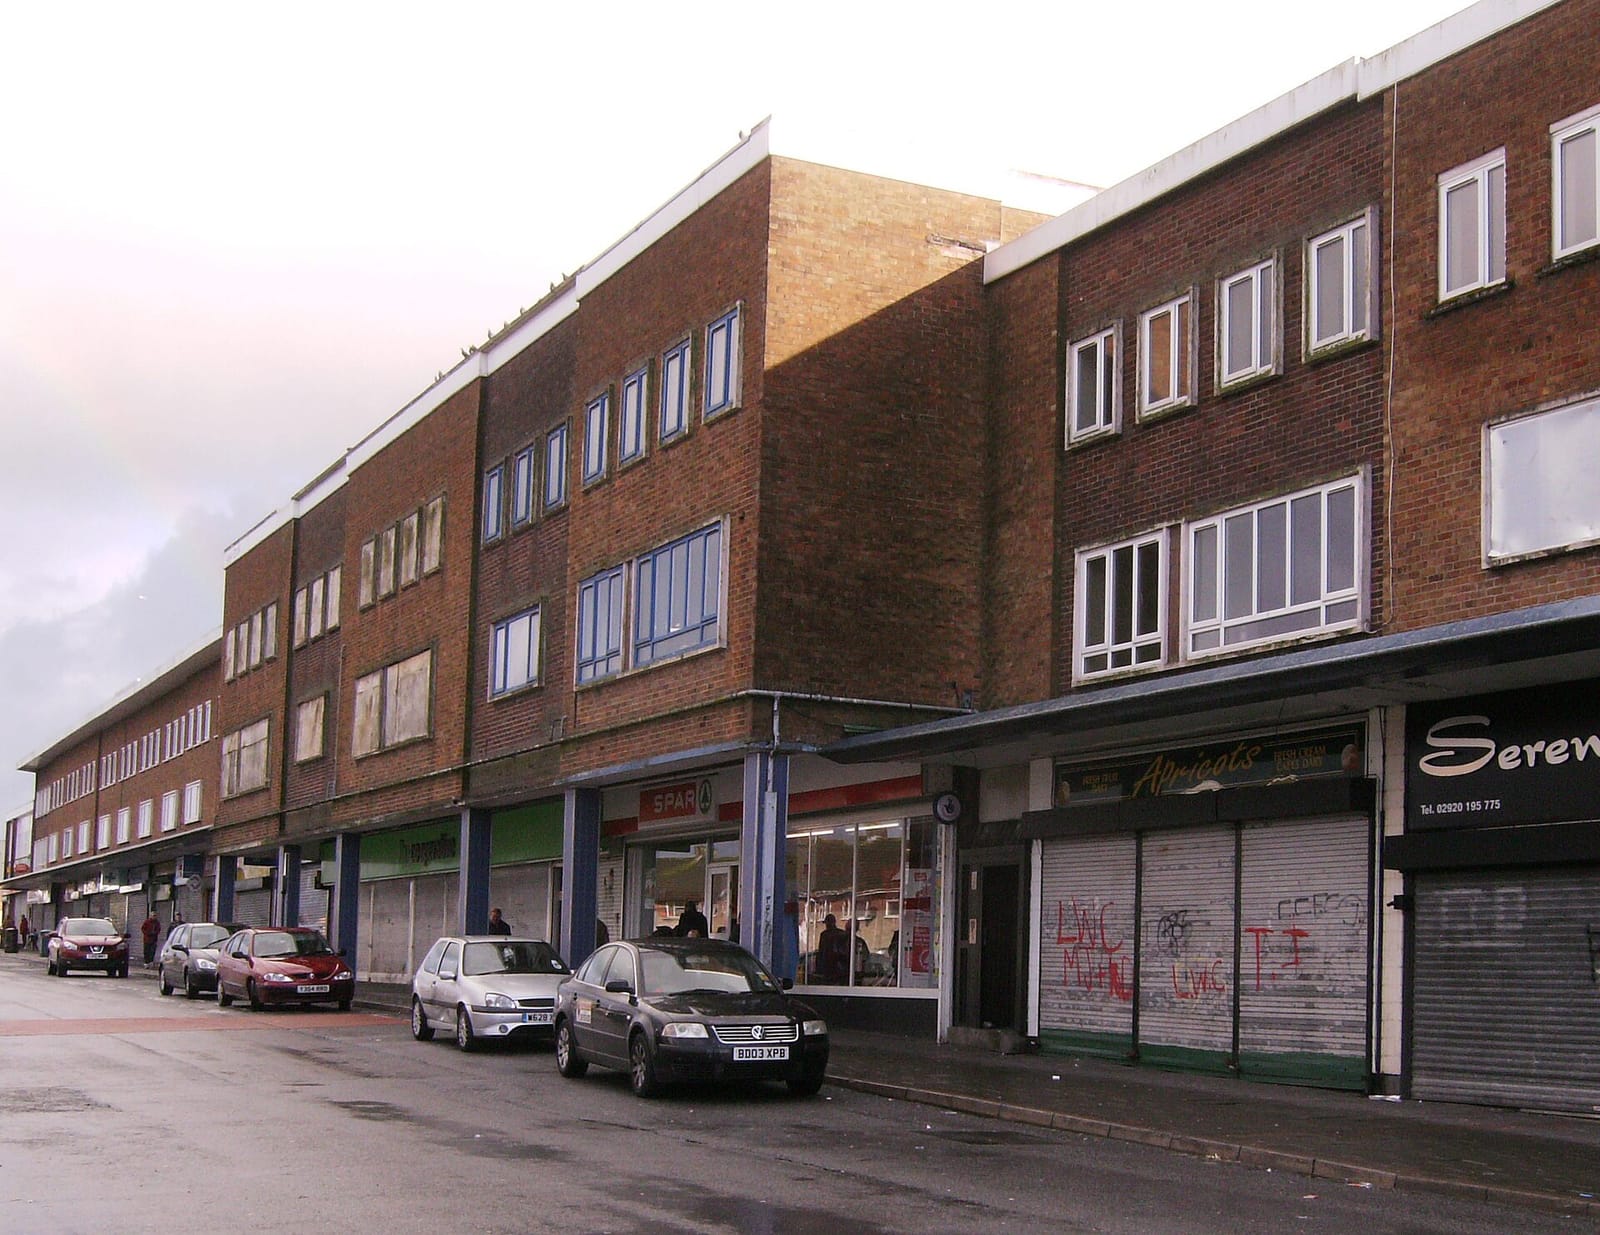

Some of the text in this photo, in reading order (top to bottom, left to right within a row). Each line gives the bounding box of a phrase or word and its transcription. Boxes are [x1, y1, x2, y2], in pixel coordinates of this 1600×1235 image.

[1132, 742, 1264, 800] Apricots
[654, 789, 696, 813] SPAR
[1420, 799, 1501, 815] Tel. 02920 195 775
